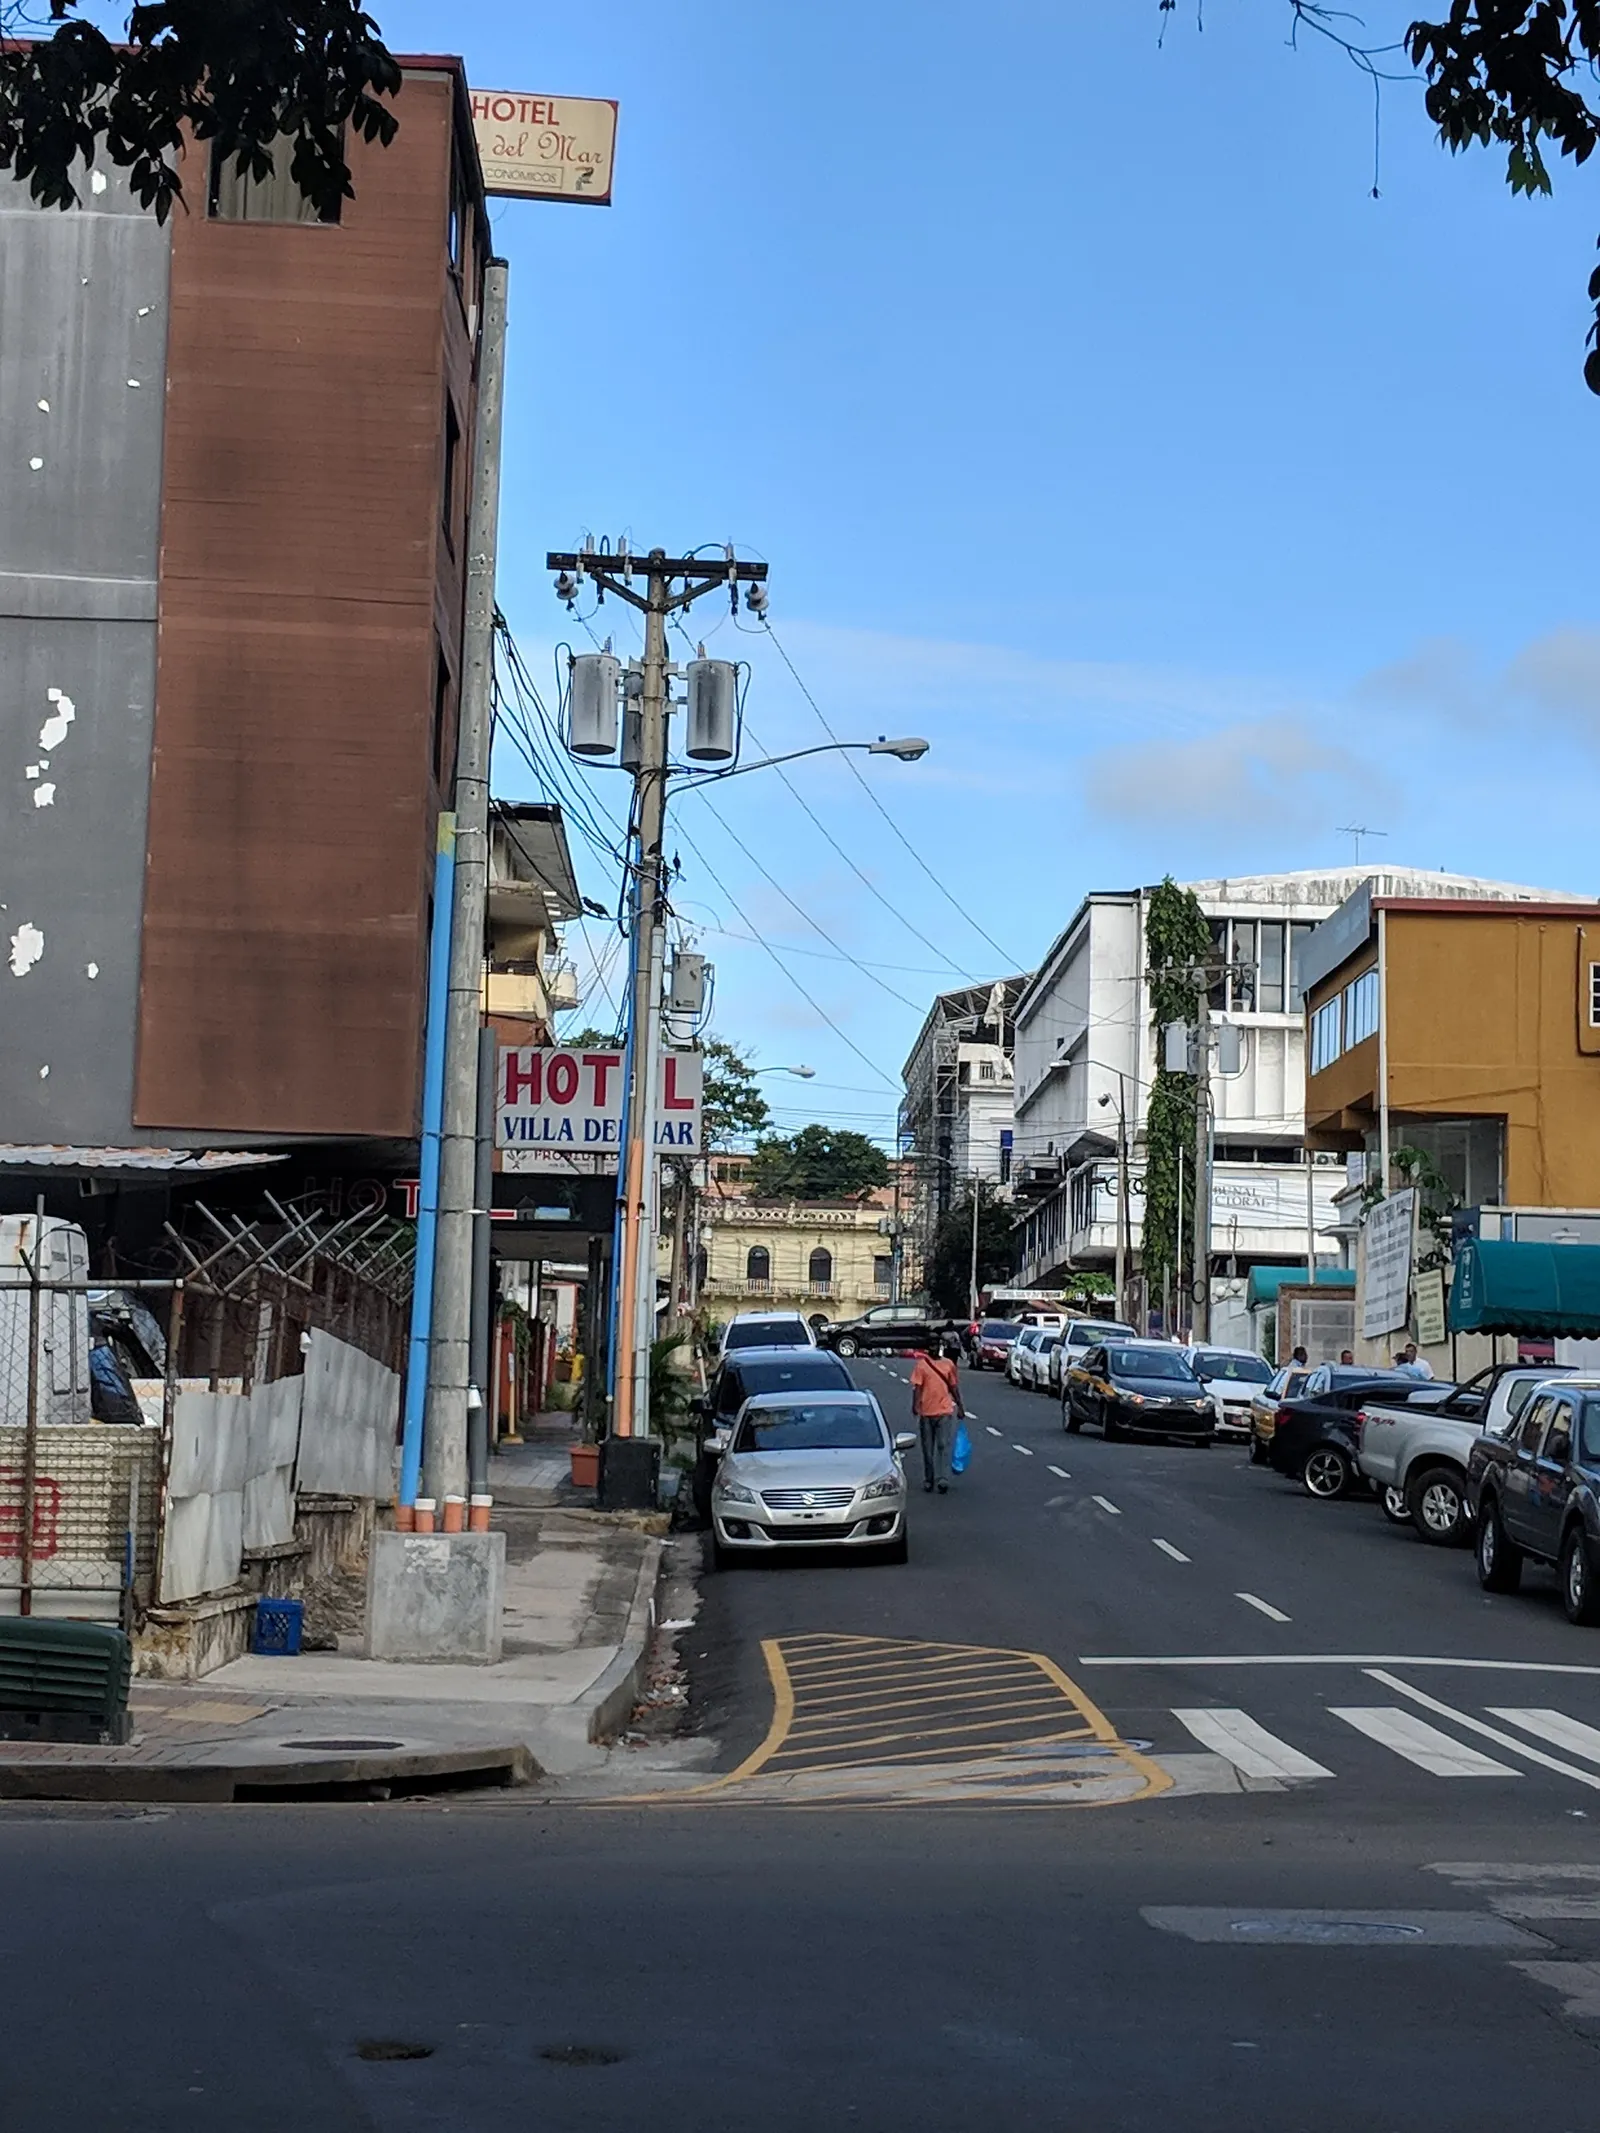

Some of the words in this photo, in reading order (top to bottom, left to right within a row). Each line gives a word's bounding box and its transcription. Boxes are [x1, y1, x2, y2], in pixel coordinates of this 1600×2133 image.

[472, 96, 560, 126] HOTEL
[492, 131, 529, 157] del
[537, 131, 603, 164] Mar
[505, 1053, 694, 1110] HOTL
[503, 1117, 574, 1142] VILLA
[655, 1120, 695, 1145] AR
